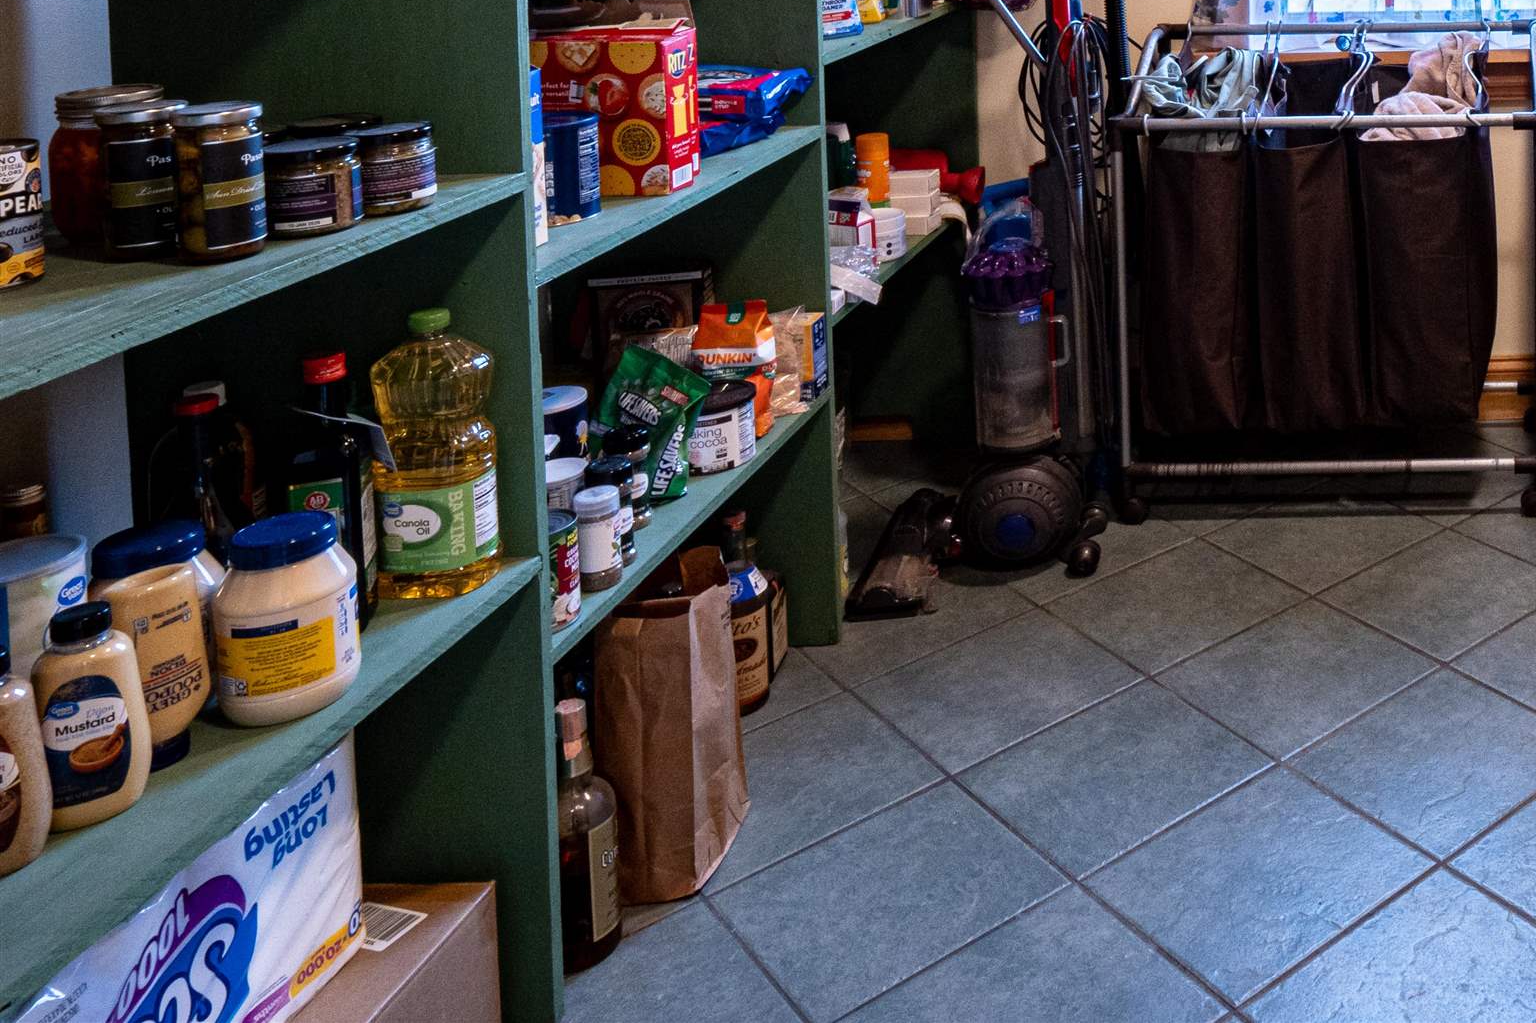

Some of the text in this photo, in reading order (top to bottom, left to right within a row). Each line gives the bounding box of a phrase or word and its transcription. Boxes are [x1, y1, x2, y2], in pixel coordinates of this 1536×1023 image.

[667, 51, 686, 74] RITZ
[546, 91, 570, 99] versatil
[689, 437, 728, 450] cocoa
[394, 518, 430, 529] Canola
[416, 526, 431, 536] Oil
[447, 488, 467, 556] BAKING
[150, 658, 188, 677] DIJON
[144, 669, 203, 704] POUPO
[149, 686, 192, 714] GREY
[54, 711, 117, 738] Mustard
[244, 769, 337, 862] Lasting
[271, 803, 329, 870] Long
[115, 890, 192, 1014] 1000
[296, 938, 342, 985] 20,000
